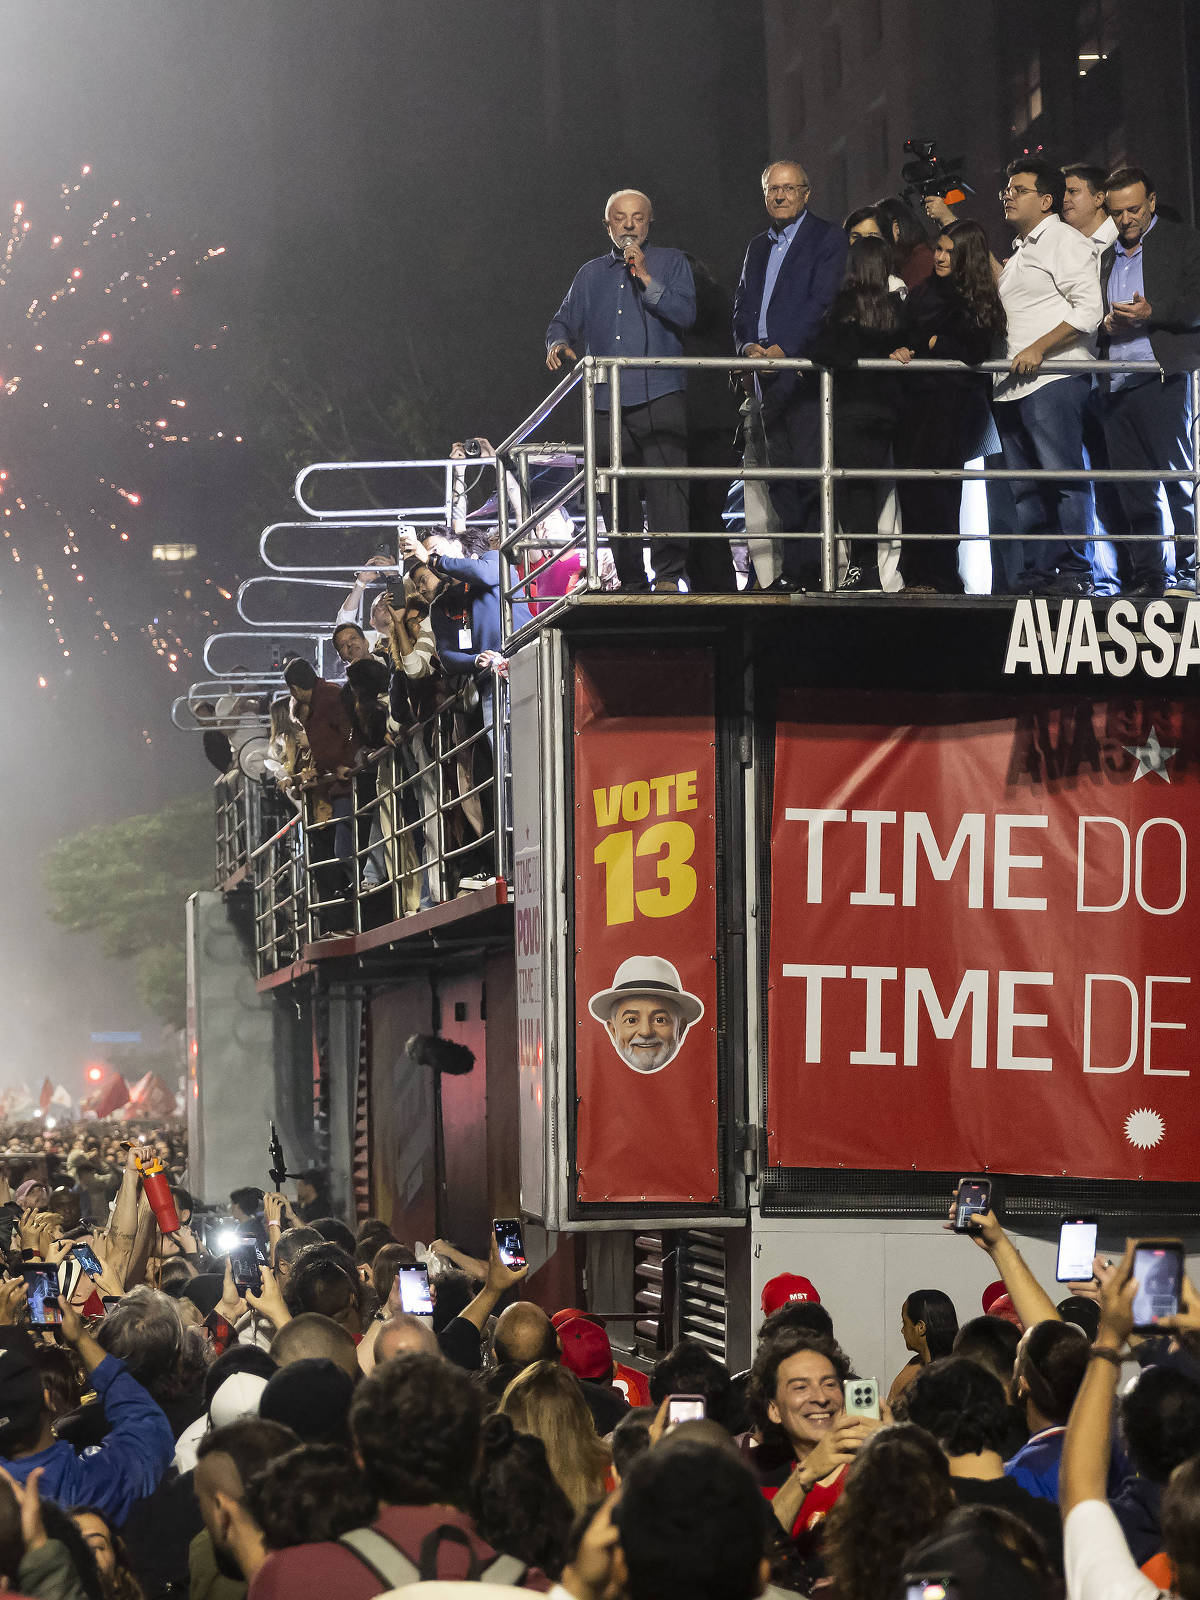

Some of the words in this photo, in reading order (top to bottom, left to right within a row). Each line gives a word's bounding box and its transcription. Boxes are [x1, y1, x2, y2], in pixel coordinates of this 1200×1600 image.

[593, 770, 698, 828] VOTE
[593, 822, 697, 926] 13
[784, 807, 1049, 911] TIME
[1076, 815, 1187, 916] DO
[517, 905, 540, 956] POVO
[783, 963, 1054, 1072] TIME
[1082, 972, 1192, 1077] DE
[789, 1293, 808, 1301] MST
